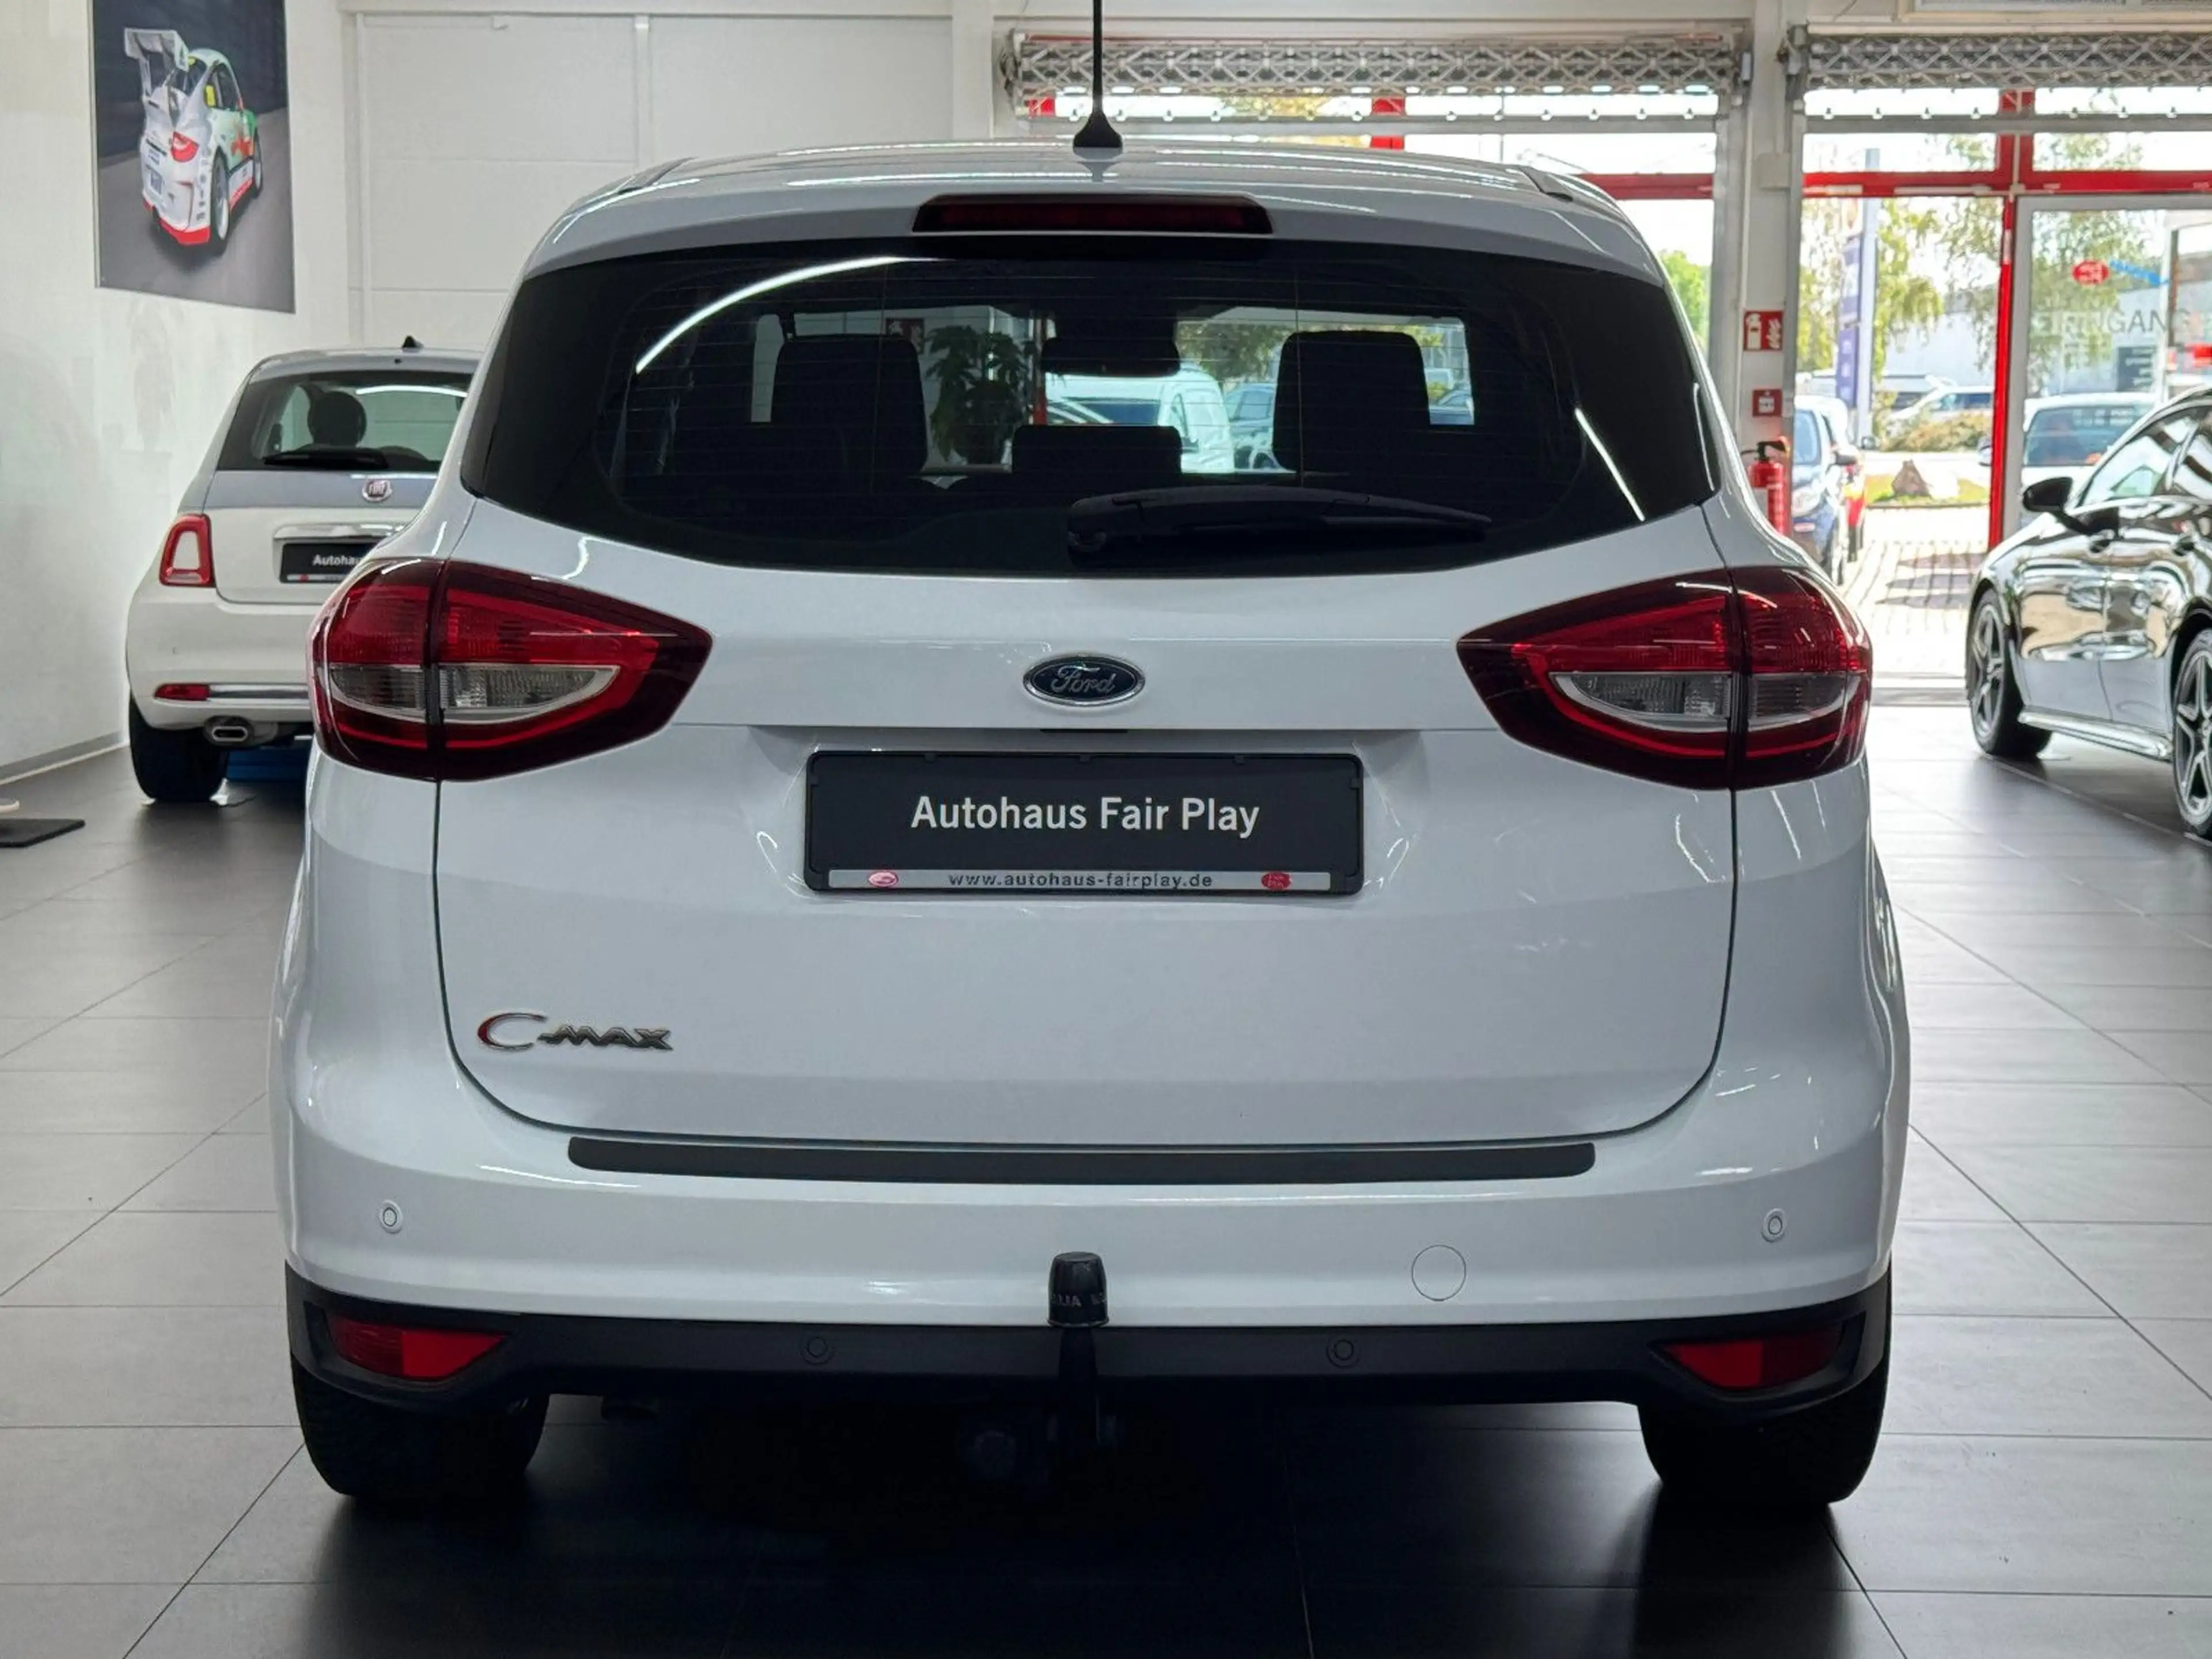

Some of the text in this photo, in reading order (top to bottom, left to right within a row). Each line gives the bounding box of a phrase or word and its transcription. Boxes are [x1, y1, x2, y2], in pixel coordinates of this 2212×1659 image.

[312, 554, 365, 566] Autohau
[1051, 665, 1116, 693] Ford
[911, 796, 1260, 839] Autohaus Fair Play
[949, 872, 1213, 889] www.autohaus-fairplay.de
